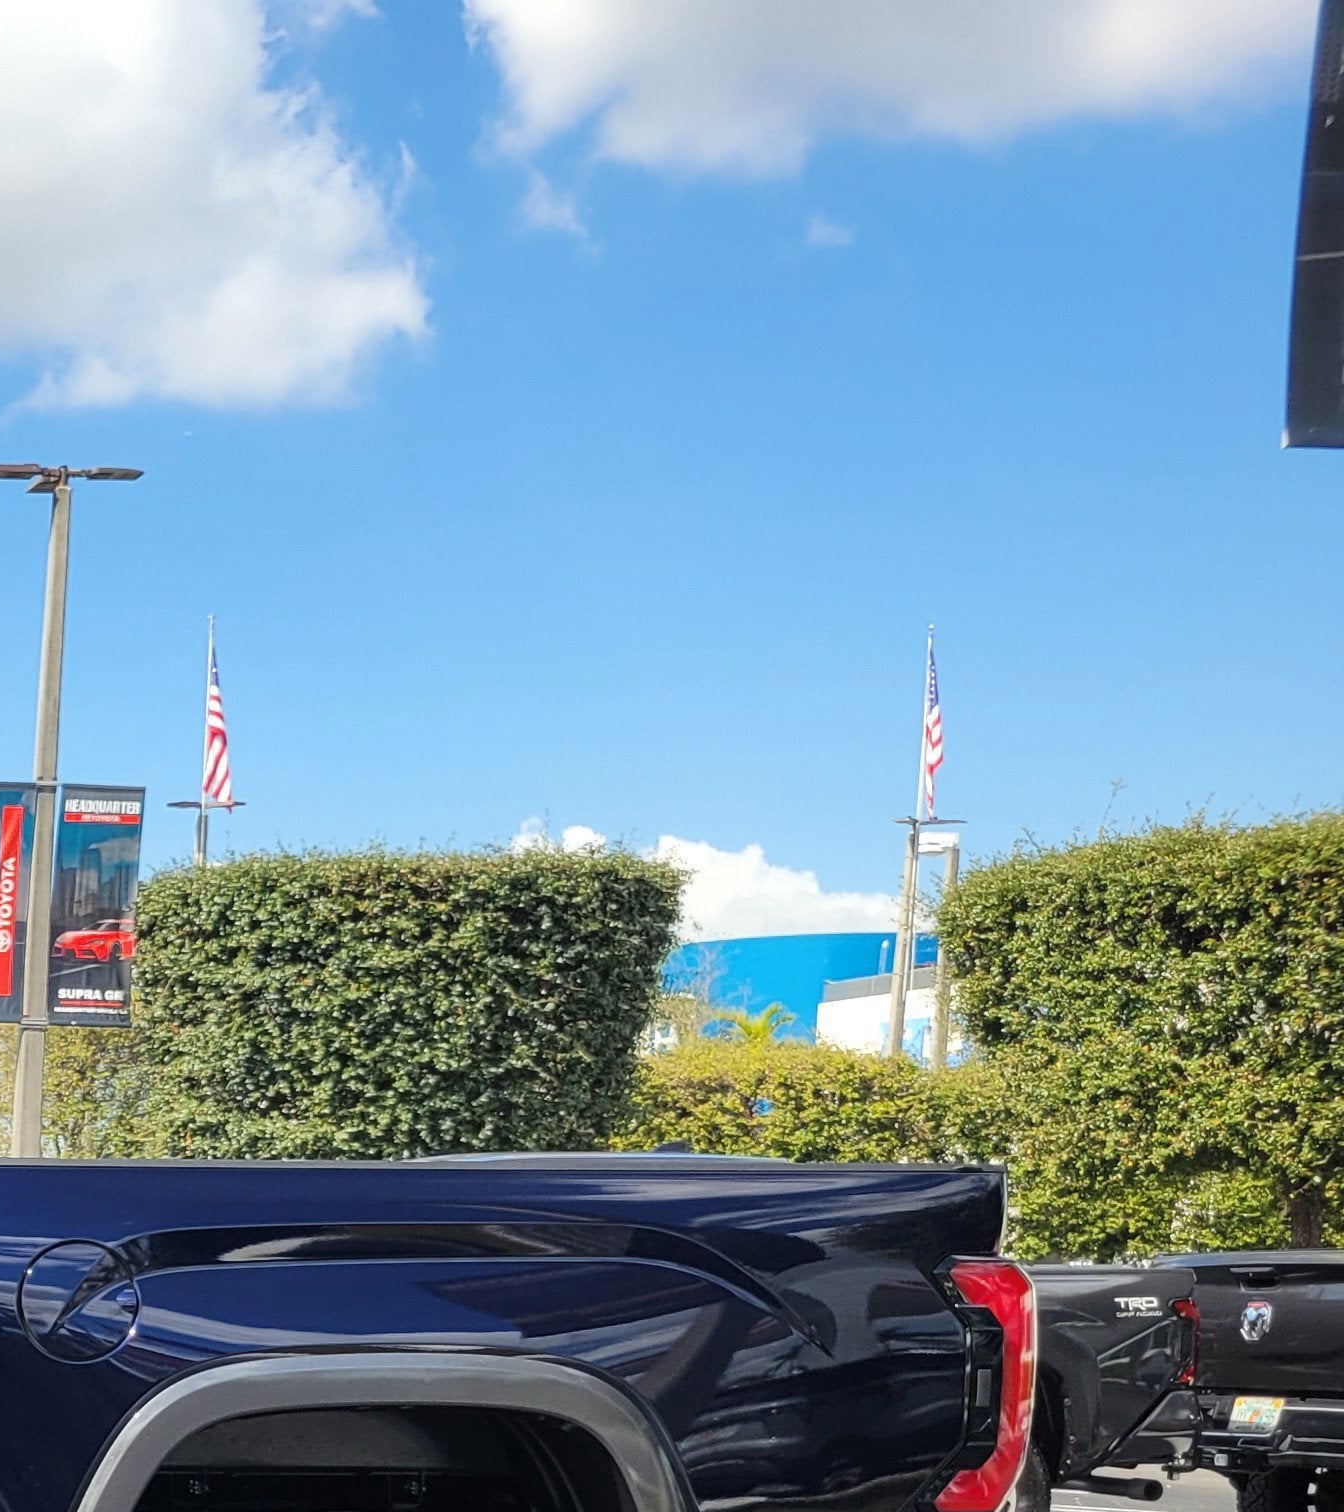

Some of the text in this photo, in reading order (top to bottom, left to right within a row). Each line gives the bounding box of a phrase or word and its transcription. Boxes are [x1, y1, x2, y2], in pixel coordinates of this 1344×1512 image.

[64, 799, 141, 814] HEADQUARTER
[58, 988, 124, 1002] SUPRA GR
[1114, 1296, 1158, 1311] TRD
